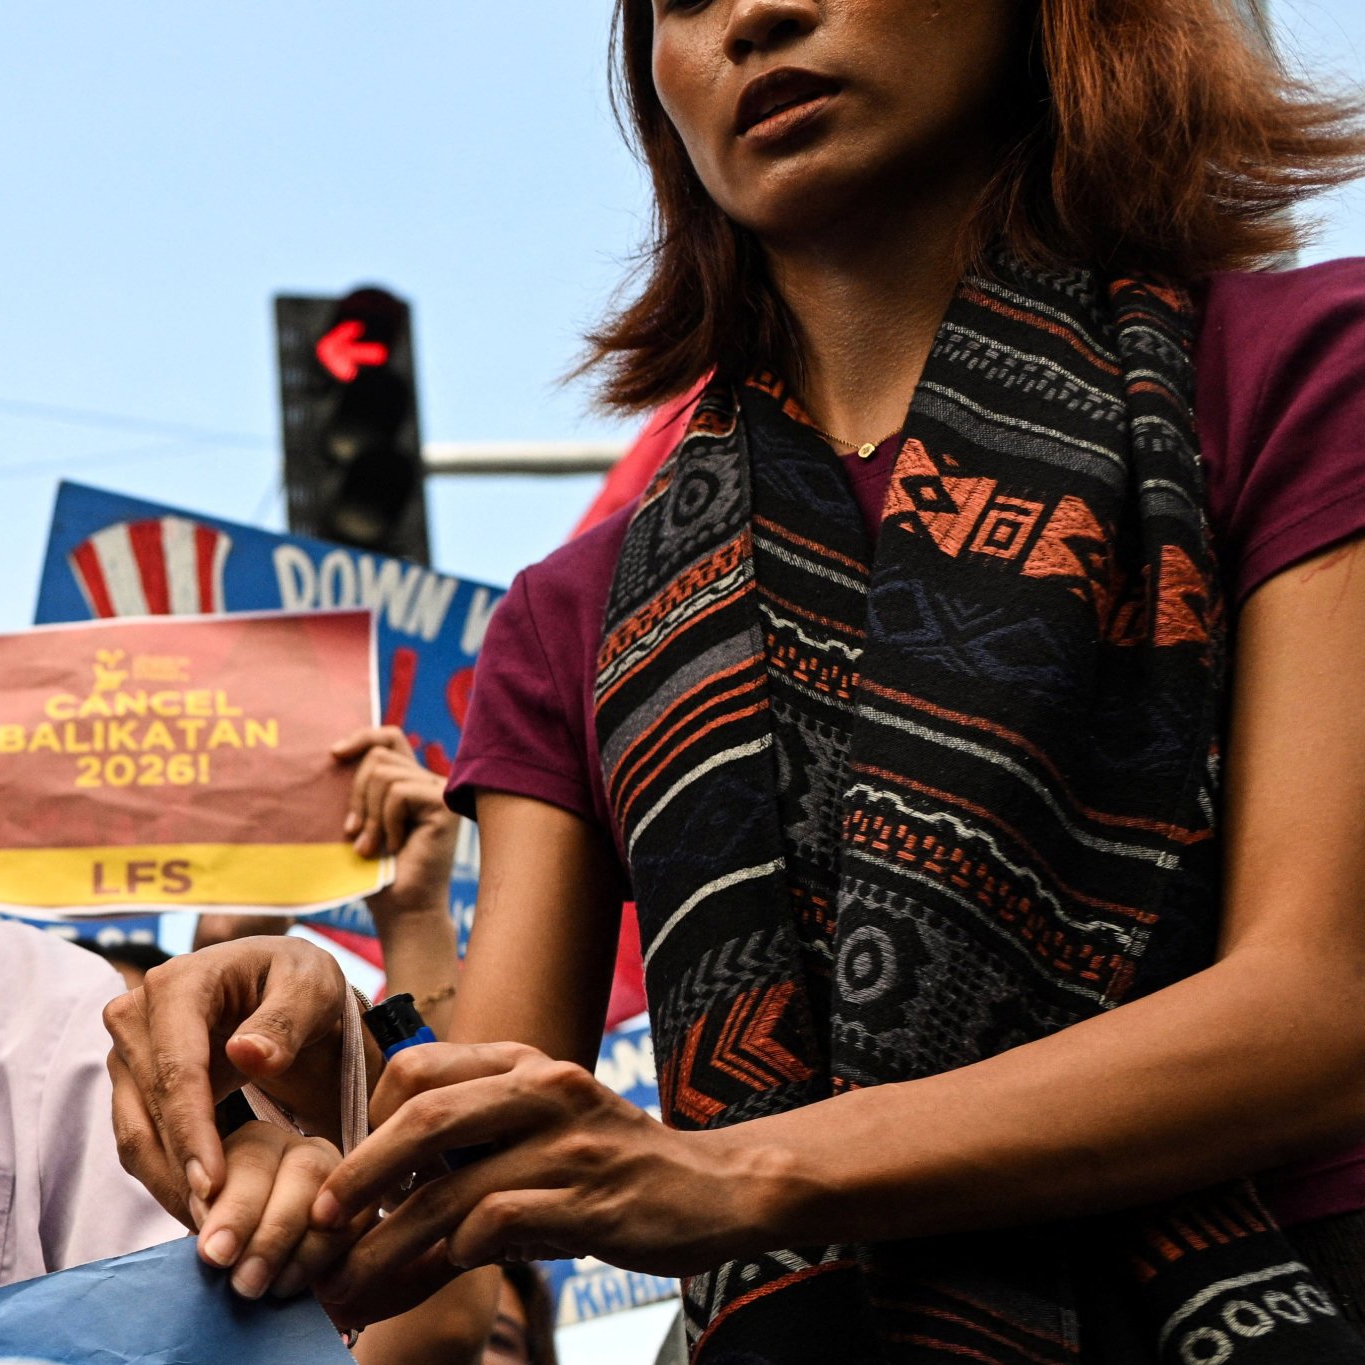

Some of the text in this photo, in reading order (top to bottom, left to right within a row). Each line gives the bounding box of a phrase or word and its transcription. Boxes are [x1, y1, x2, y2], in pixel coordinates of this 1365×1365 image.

[274, 544, 458, 642] DOWN
[45, 689, 243, 719] CANCEL
[75, 753, 210, 788] 2026!
[92, 859, 193, 895] LFS
